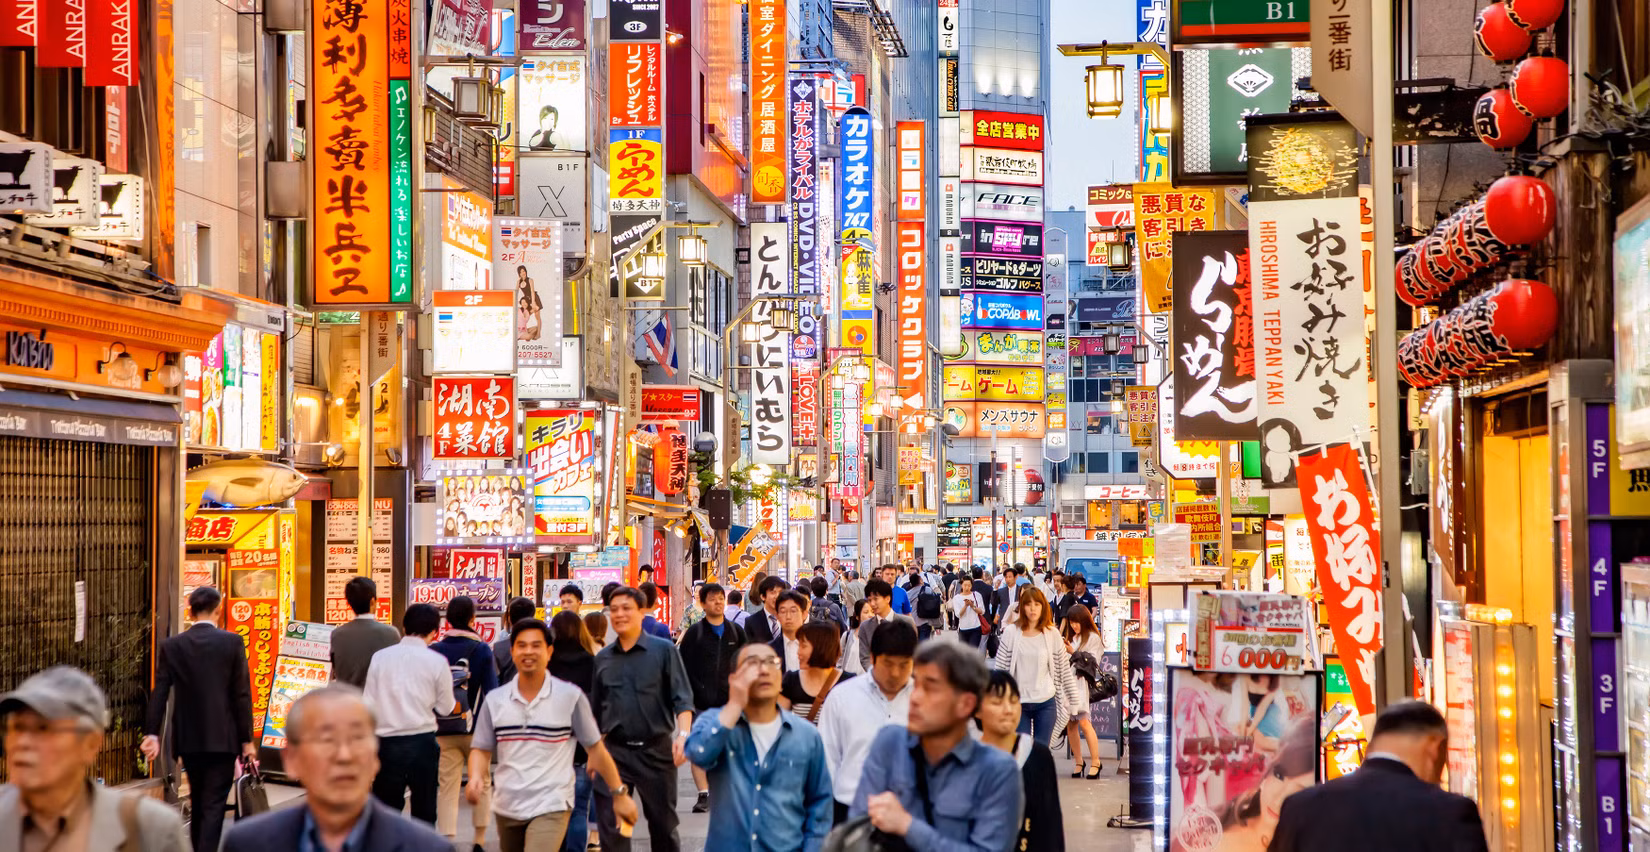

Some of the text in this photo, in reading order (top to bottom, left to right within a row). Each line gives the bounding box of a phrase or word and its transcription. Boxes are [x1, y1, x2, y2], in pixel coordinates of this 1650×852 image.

[16, 0, 36, 37] AN
[1266, 2, 1296, 20] B1
[629, 23, 642, 31] 3F
[627, 45, 642, 125] リフレッシュ
[759, 0, 775, 152] 室ダイニング居酒屋
[647, 95, 656, 121] ホステル
[627, 130, 645, 139] 1F
[976, 119, 1040, 141] 全店営業中
[793, 101, 814, 200] ホテルがライバル
[557, 163, 579, 171] B1F
[844, 115, 869, 210] カラオケ
[977, 192, 1040, 207] FACE
[1141, 193, 1206, 214] 悪質な
[844, 212, 870, 227] 747
[513, 227, 551, 238] タイ古式
[612, 218, 657, 245] Party Space
[501, 239, 551, 250] マッサージ
[501, 253, 515, 261] 2F
[1259, 220, 1280, 301] HIROSHIMA
[996, 277, 1018, 289] ゴルフ
[464, 295, 483, 305] 2F
[1290, 217, 1363, 421] お好み焼き
[978, 377, 1018, 395] ゲーム
[437, 378, 511, 420] 湖南
[981, 409, 1039, 423] メンズサウナ
[532, 412, 584, 443] キラリ
[528, 431, 593, 480] 出会い
[1592, 439, 1606, 478] 5F
[553, 463, 593, 494] カフェ
[1100, 487, 1141, 498] コーヒー
[1188, 523, 1221, 532] 内所組合
[244, 551, 262, 564] 20
[376, 546, 390, 554] 980
[523, 565, 534, 600] 歌舞伎
[1593, 558, 1607, 596] 4F
[412, 584, 500, 604] 19:00 オープン
[234, 606, 250, 614] 120
[1599, 674, 1614, 714] 3F
[1601, 796, 1616, 835] B1
